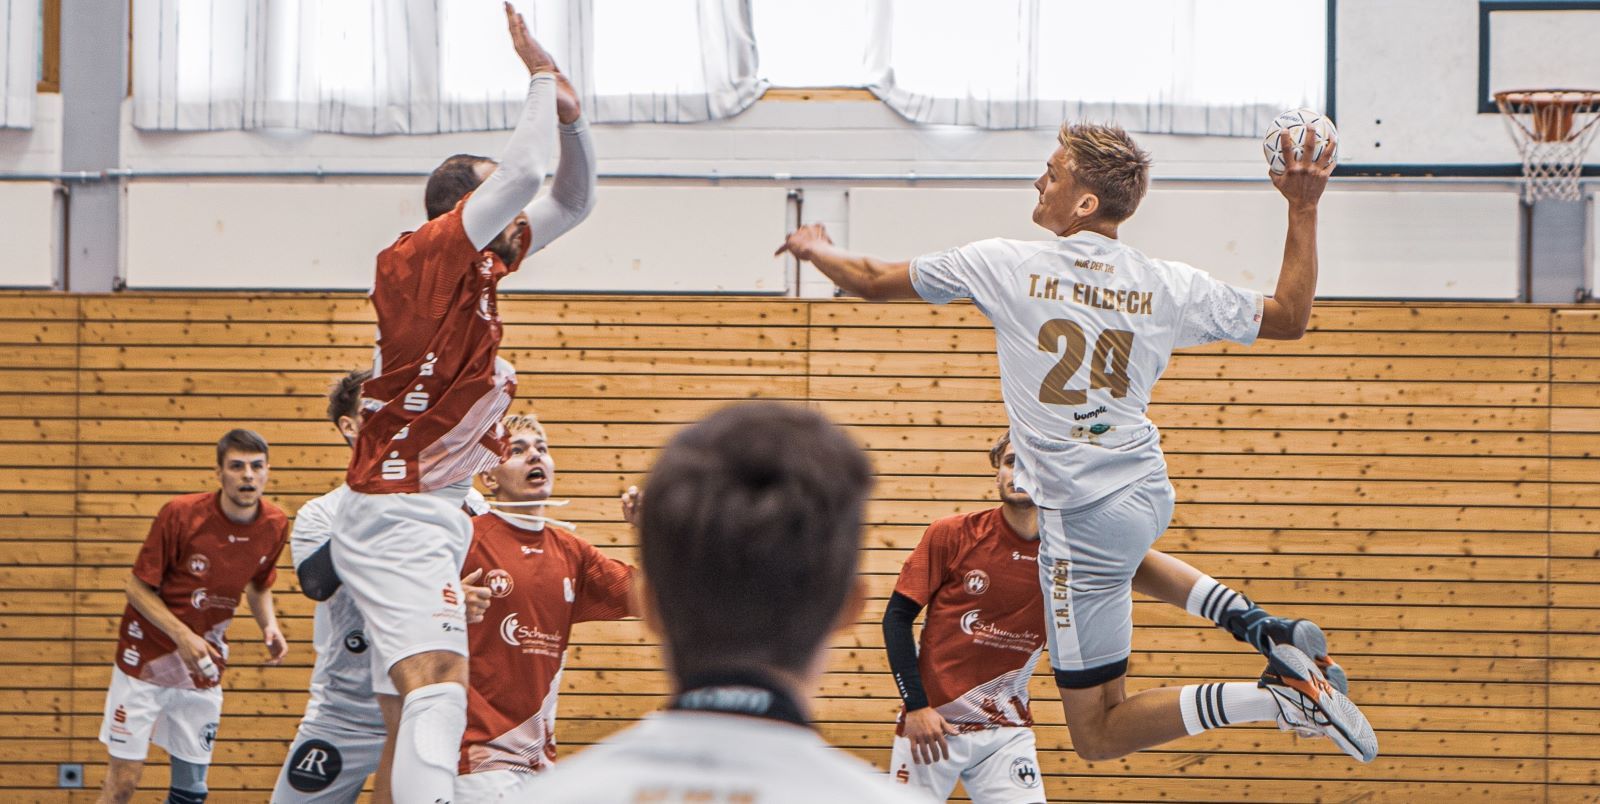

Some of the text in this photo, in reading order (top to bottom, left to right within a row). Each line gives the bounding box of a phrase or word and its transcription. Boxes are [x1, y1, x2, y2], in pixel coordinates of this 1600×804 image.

[1029, 273, 1153, 315] T.H. EILBECK
[1037, 318, 1135, 406] 24
